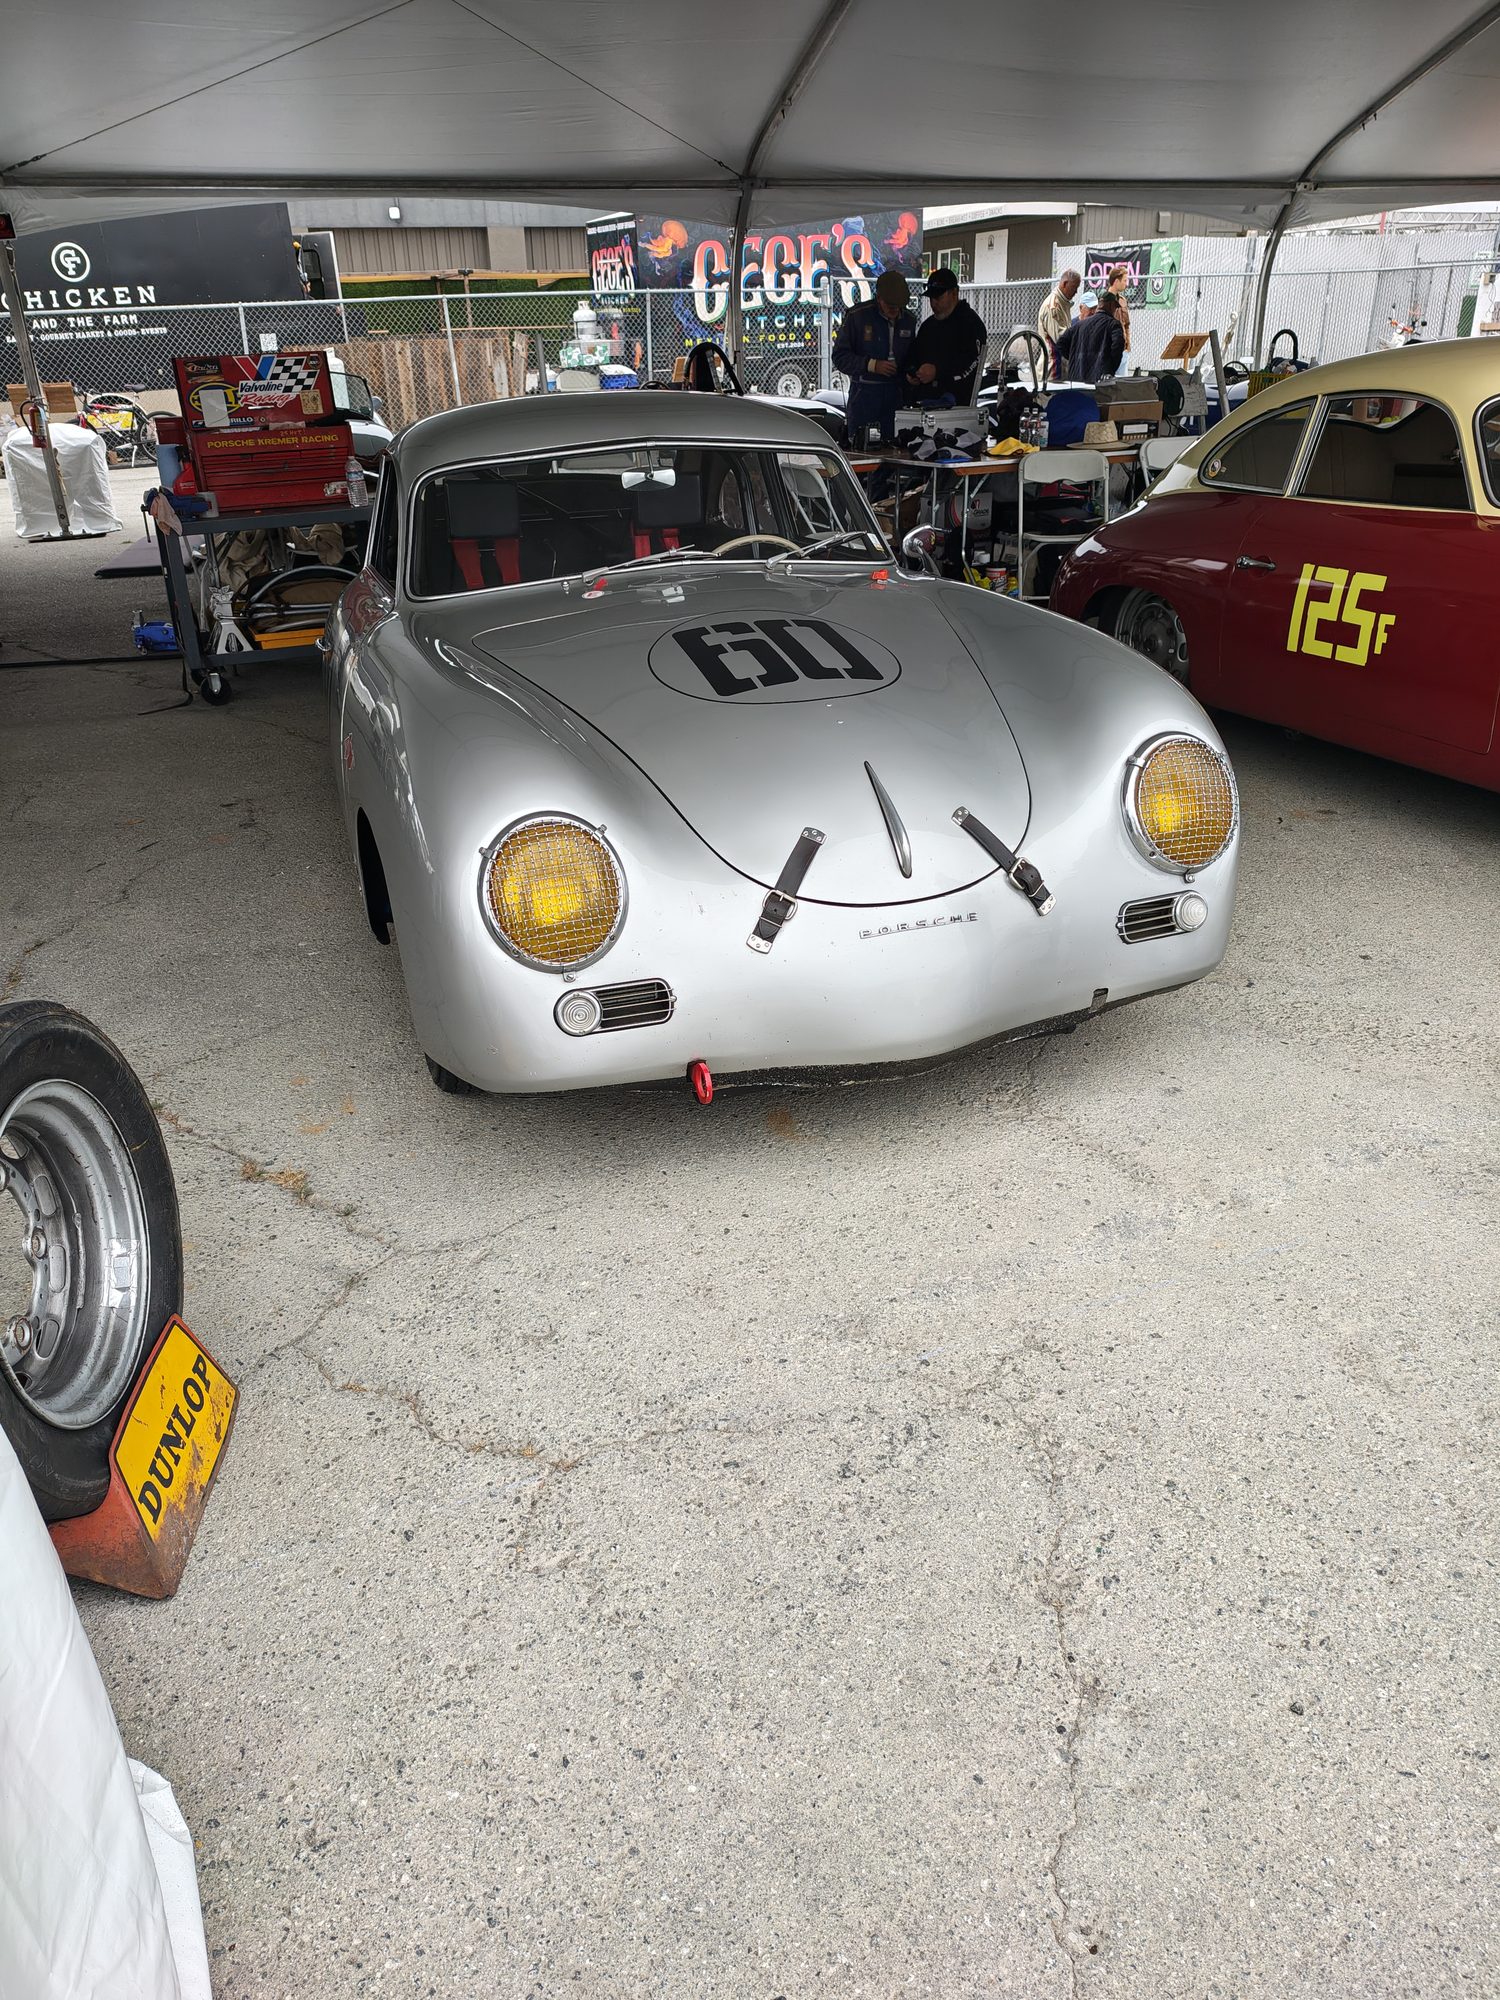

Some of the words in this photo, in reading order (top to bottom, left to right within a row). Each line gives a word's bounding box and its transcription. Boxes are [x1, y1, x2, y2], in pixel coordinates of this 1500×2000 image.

[1087, 261, 1140, 288] OPN
[32, 317, 58, 330] AND
[67, 316, 94, 328] THE
[103, 313, 138, 326] FARM
[744, 313, 843, 331] ITCHEN
[684, 335, 750, 347] MEXIN
[759, 331, 796, 343] FOOD
[239, 381, 283, 394] Valvoline
[240, 393, 292, 407] Racing
[207, 440, 256, 449] PORSCHE
[258, 437, 299, 446] KREMER
[301, 434, 339, 443] RACING
[672, 619, 884, 697] 60
[859, 912, 979, 939] PORSCHE
[138, 1353, 213, 1525] DUNLOP
